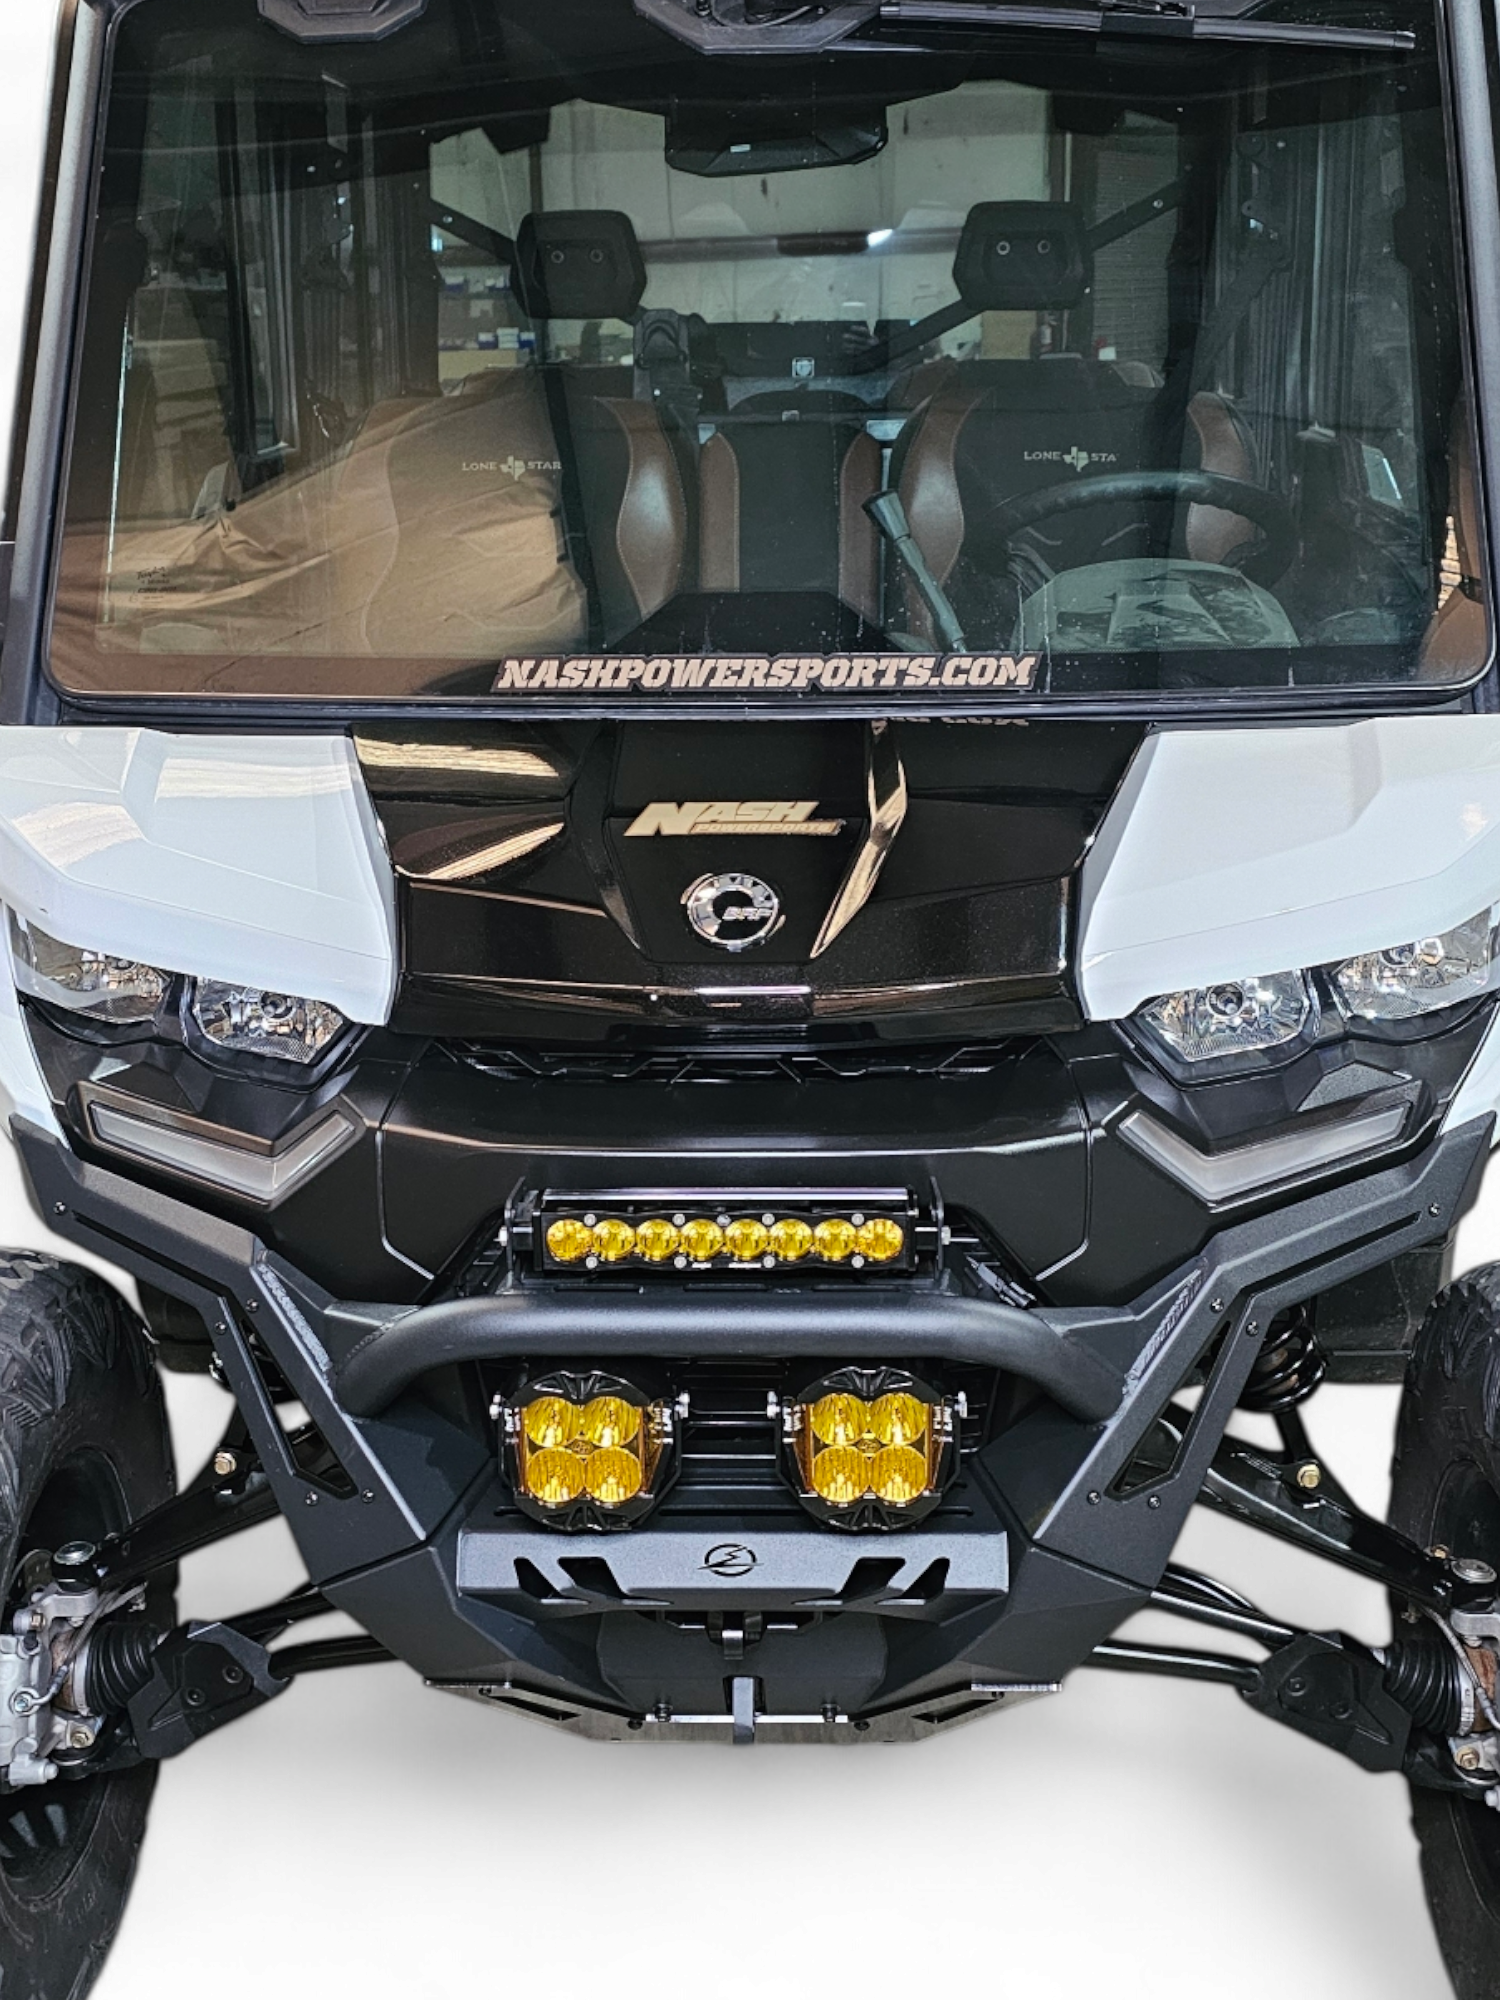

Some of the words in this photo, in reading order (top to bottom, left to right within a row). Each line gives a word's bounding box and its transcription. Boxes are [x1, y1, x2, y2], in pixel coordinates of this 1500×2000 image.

[1023, 450, 1061, 461] LONE
[1090, 451, 1119, 462] STA
[461, 461, 498, 471] LONE
[527, 461, 562, 470] STAR
[496, 656, 1036, 690] NASHPOWERSPORTS.COM
[623, 801, 820, 837] NASH
[694, 821, 834, 834] POWERSPORTS
